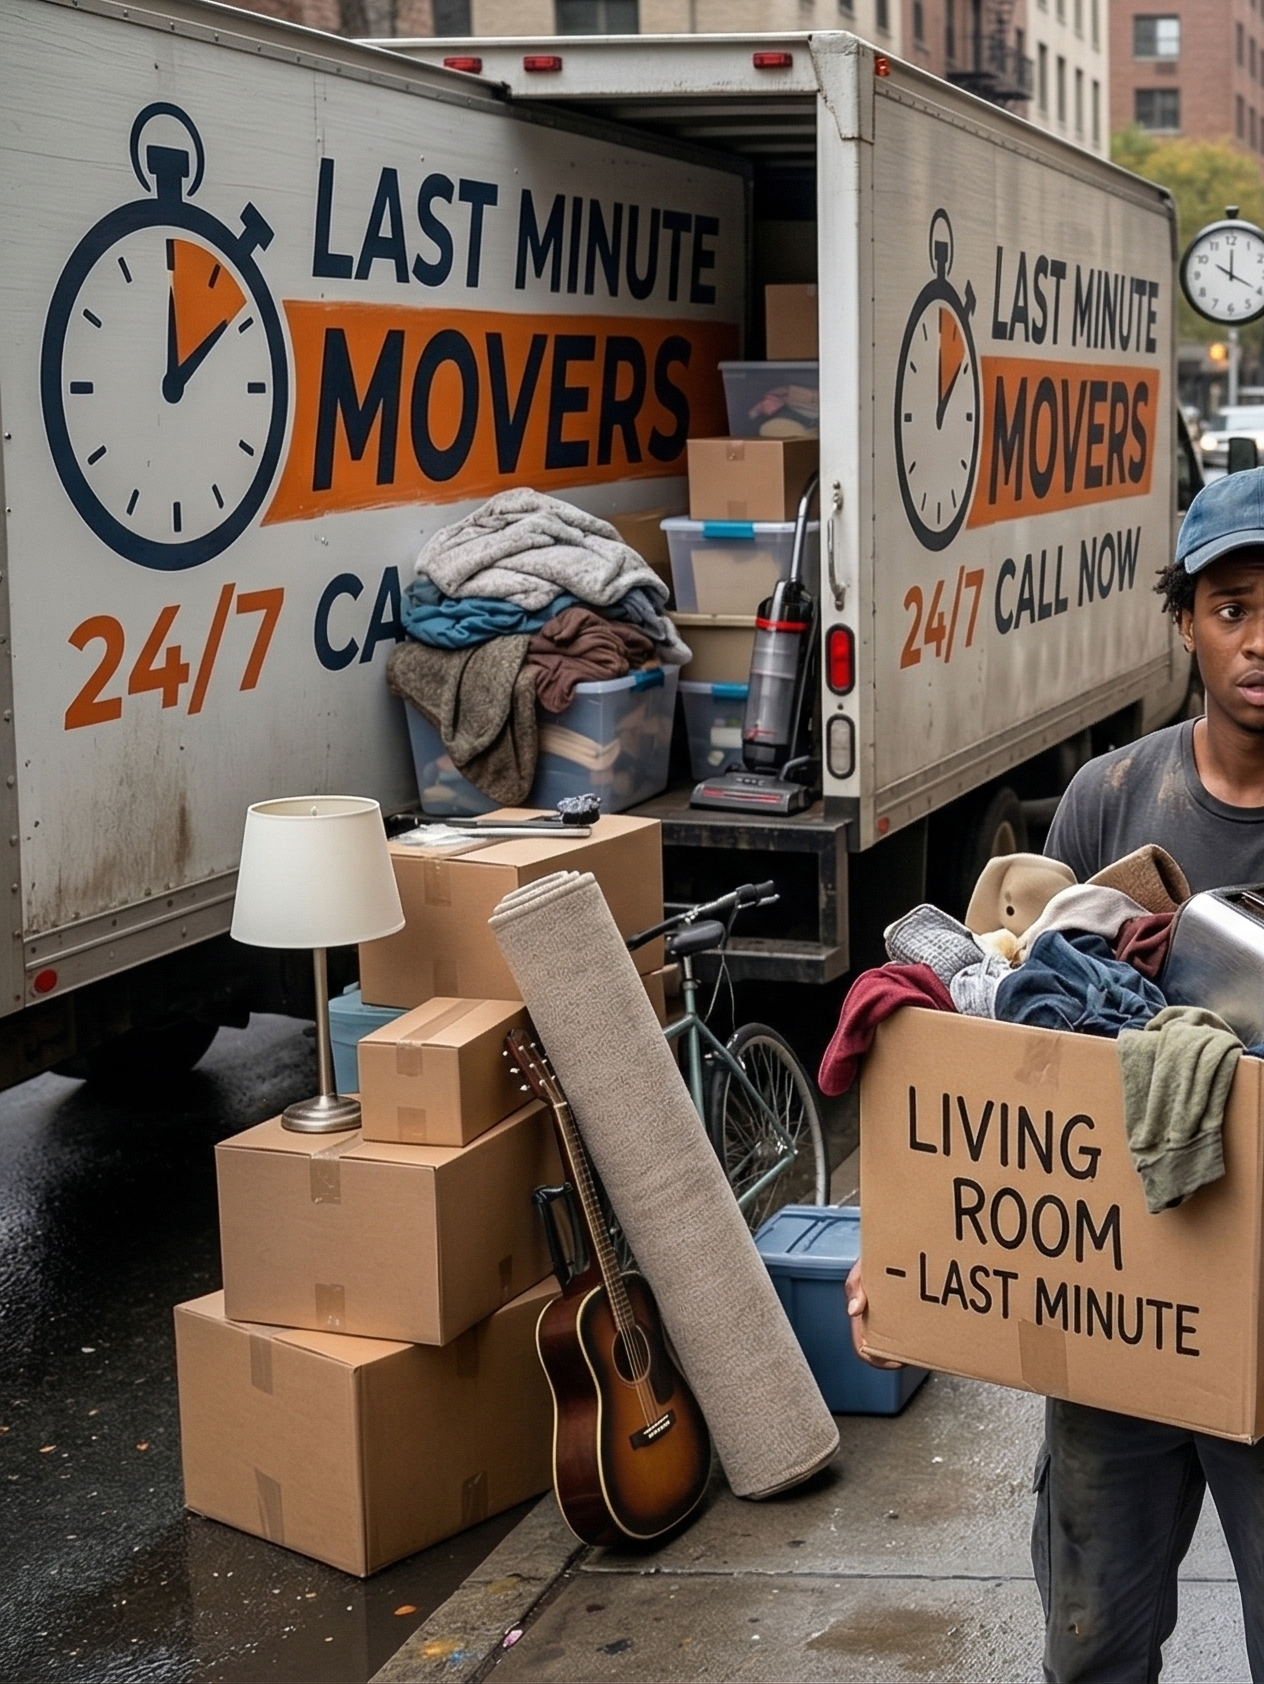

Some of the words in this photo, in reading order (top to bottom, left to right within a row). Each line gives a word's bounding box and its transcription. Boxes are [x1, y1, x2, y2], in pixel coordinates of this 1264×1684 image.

[312, 157, 498, 288] LAST
[514, 188, 720, 305] MINUTE
[991, 245, 1067, 346] LAST
[1071, 264, 1159, 354] MINUTE
[312, 328, 692, 491] MOVERS
[987, 376, 1149, 505] MOVERS
[64, 583, 285, 731] 24/7
[900, 565, 985, 670] 24/7
[994, 547, 1068, 635] CALL
[1078, 526, 1142, 607] NOW
[908, 1085, 1102, 1181] LIVING
[953, 1177, 1123, 1271] ROOM
[919, 1251, 1019, 1320] LAST
[1035, 1277, 1200, 1357] MINUTE
